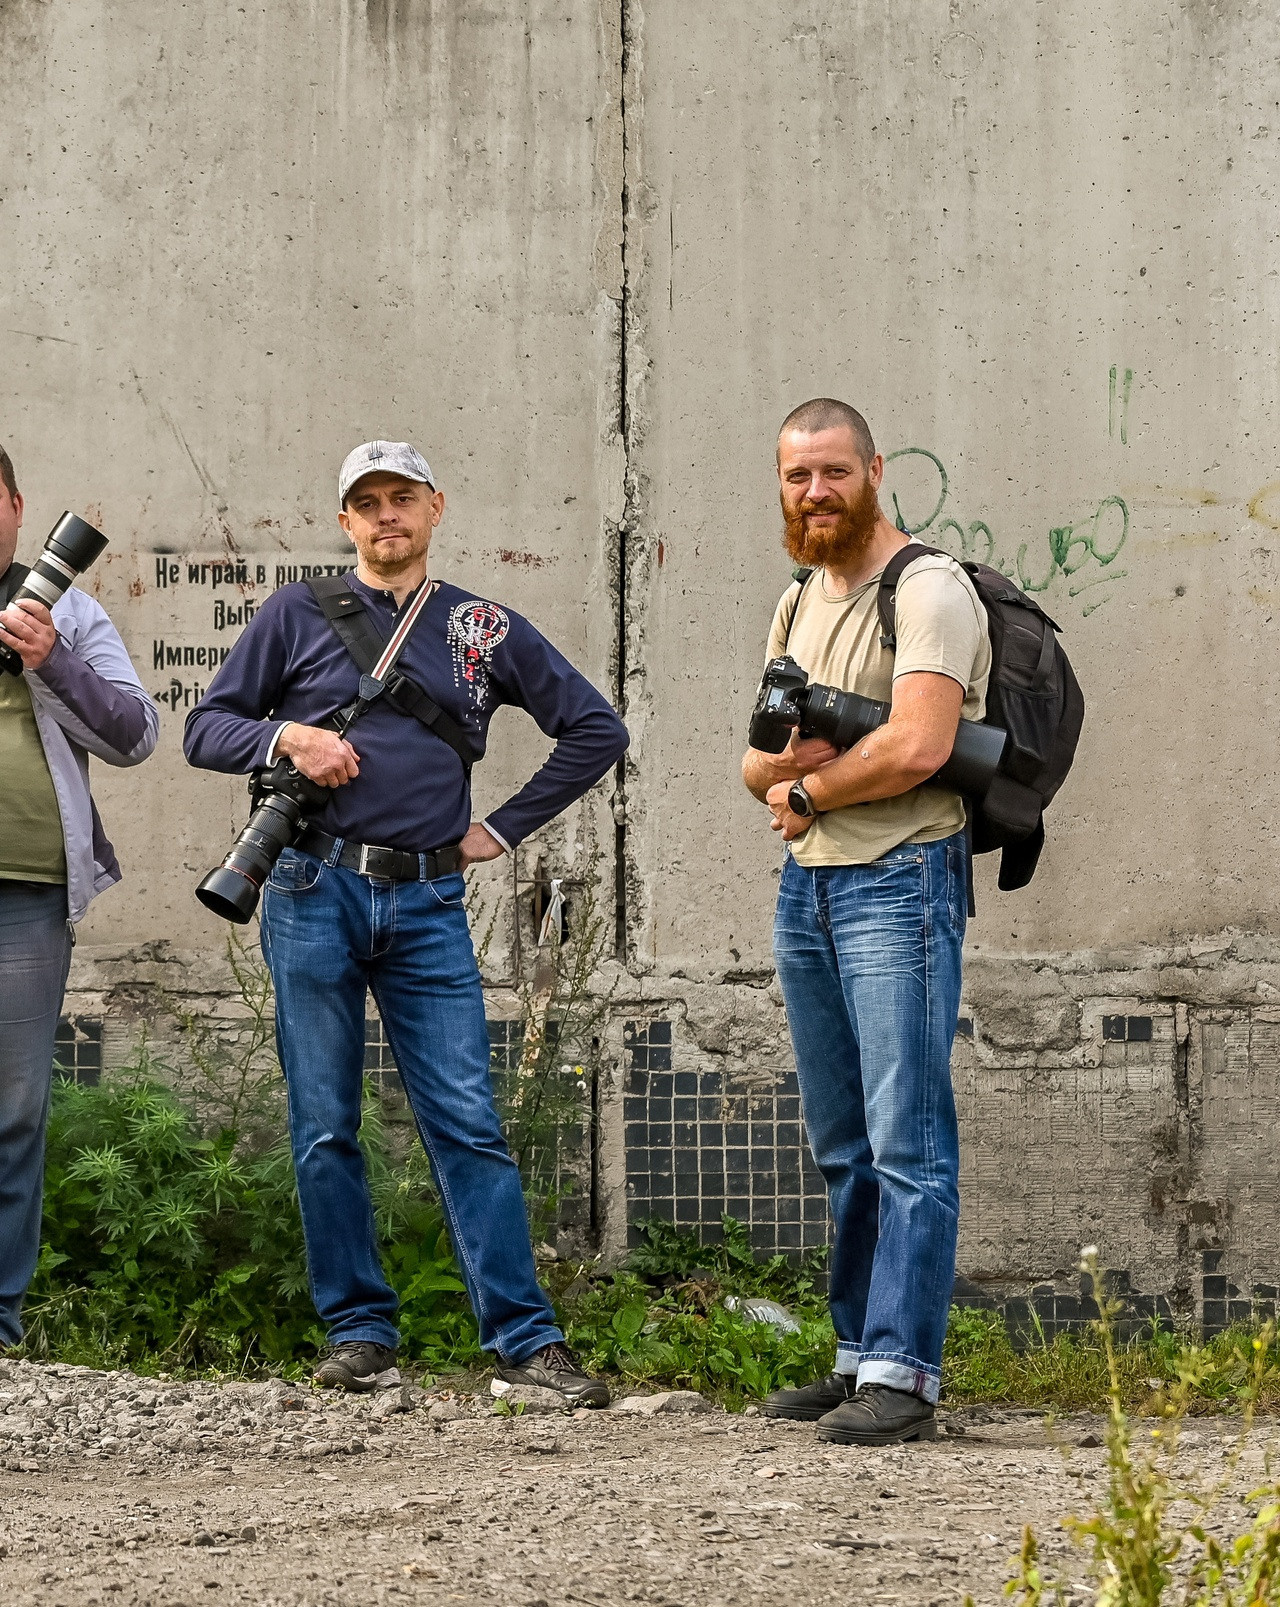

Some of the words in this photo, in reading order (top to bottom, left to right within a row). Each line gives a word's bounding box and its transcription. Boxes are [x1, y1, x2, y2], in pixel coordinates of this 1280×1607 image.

[156, 558, 179, 588] Не
[188, 559, 247, 589] играй
[256, 565, 266, 584] в
[214, 599, 260, 631] Выб
